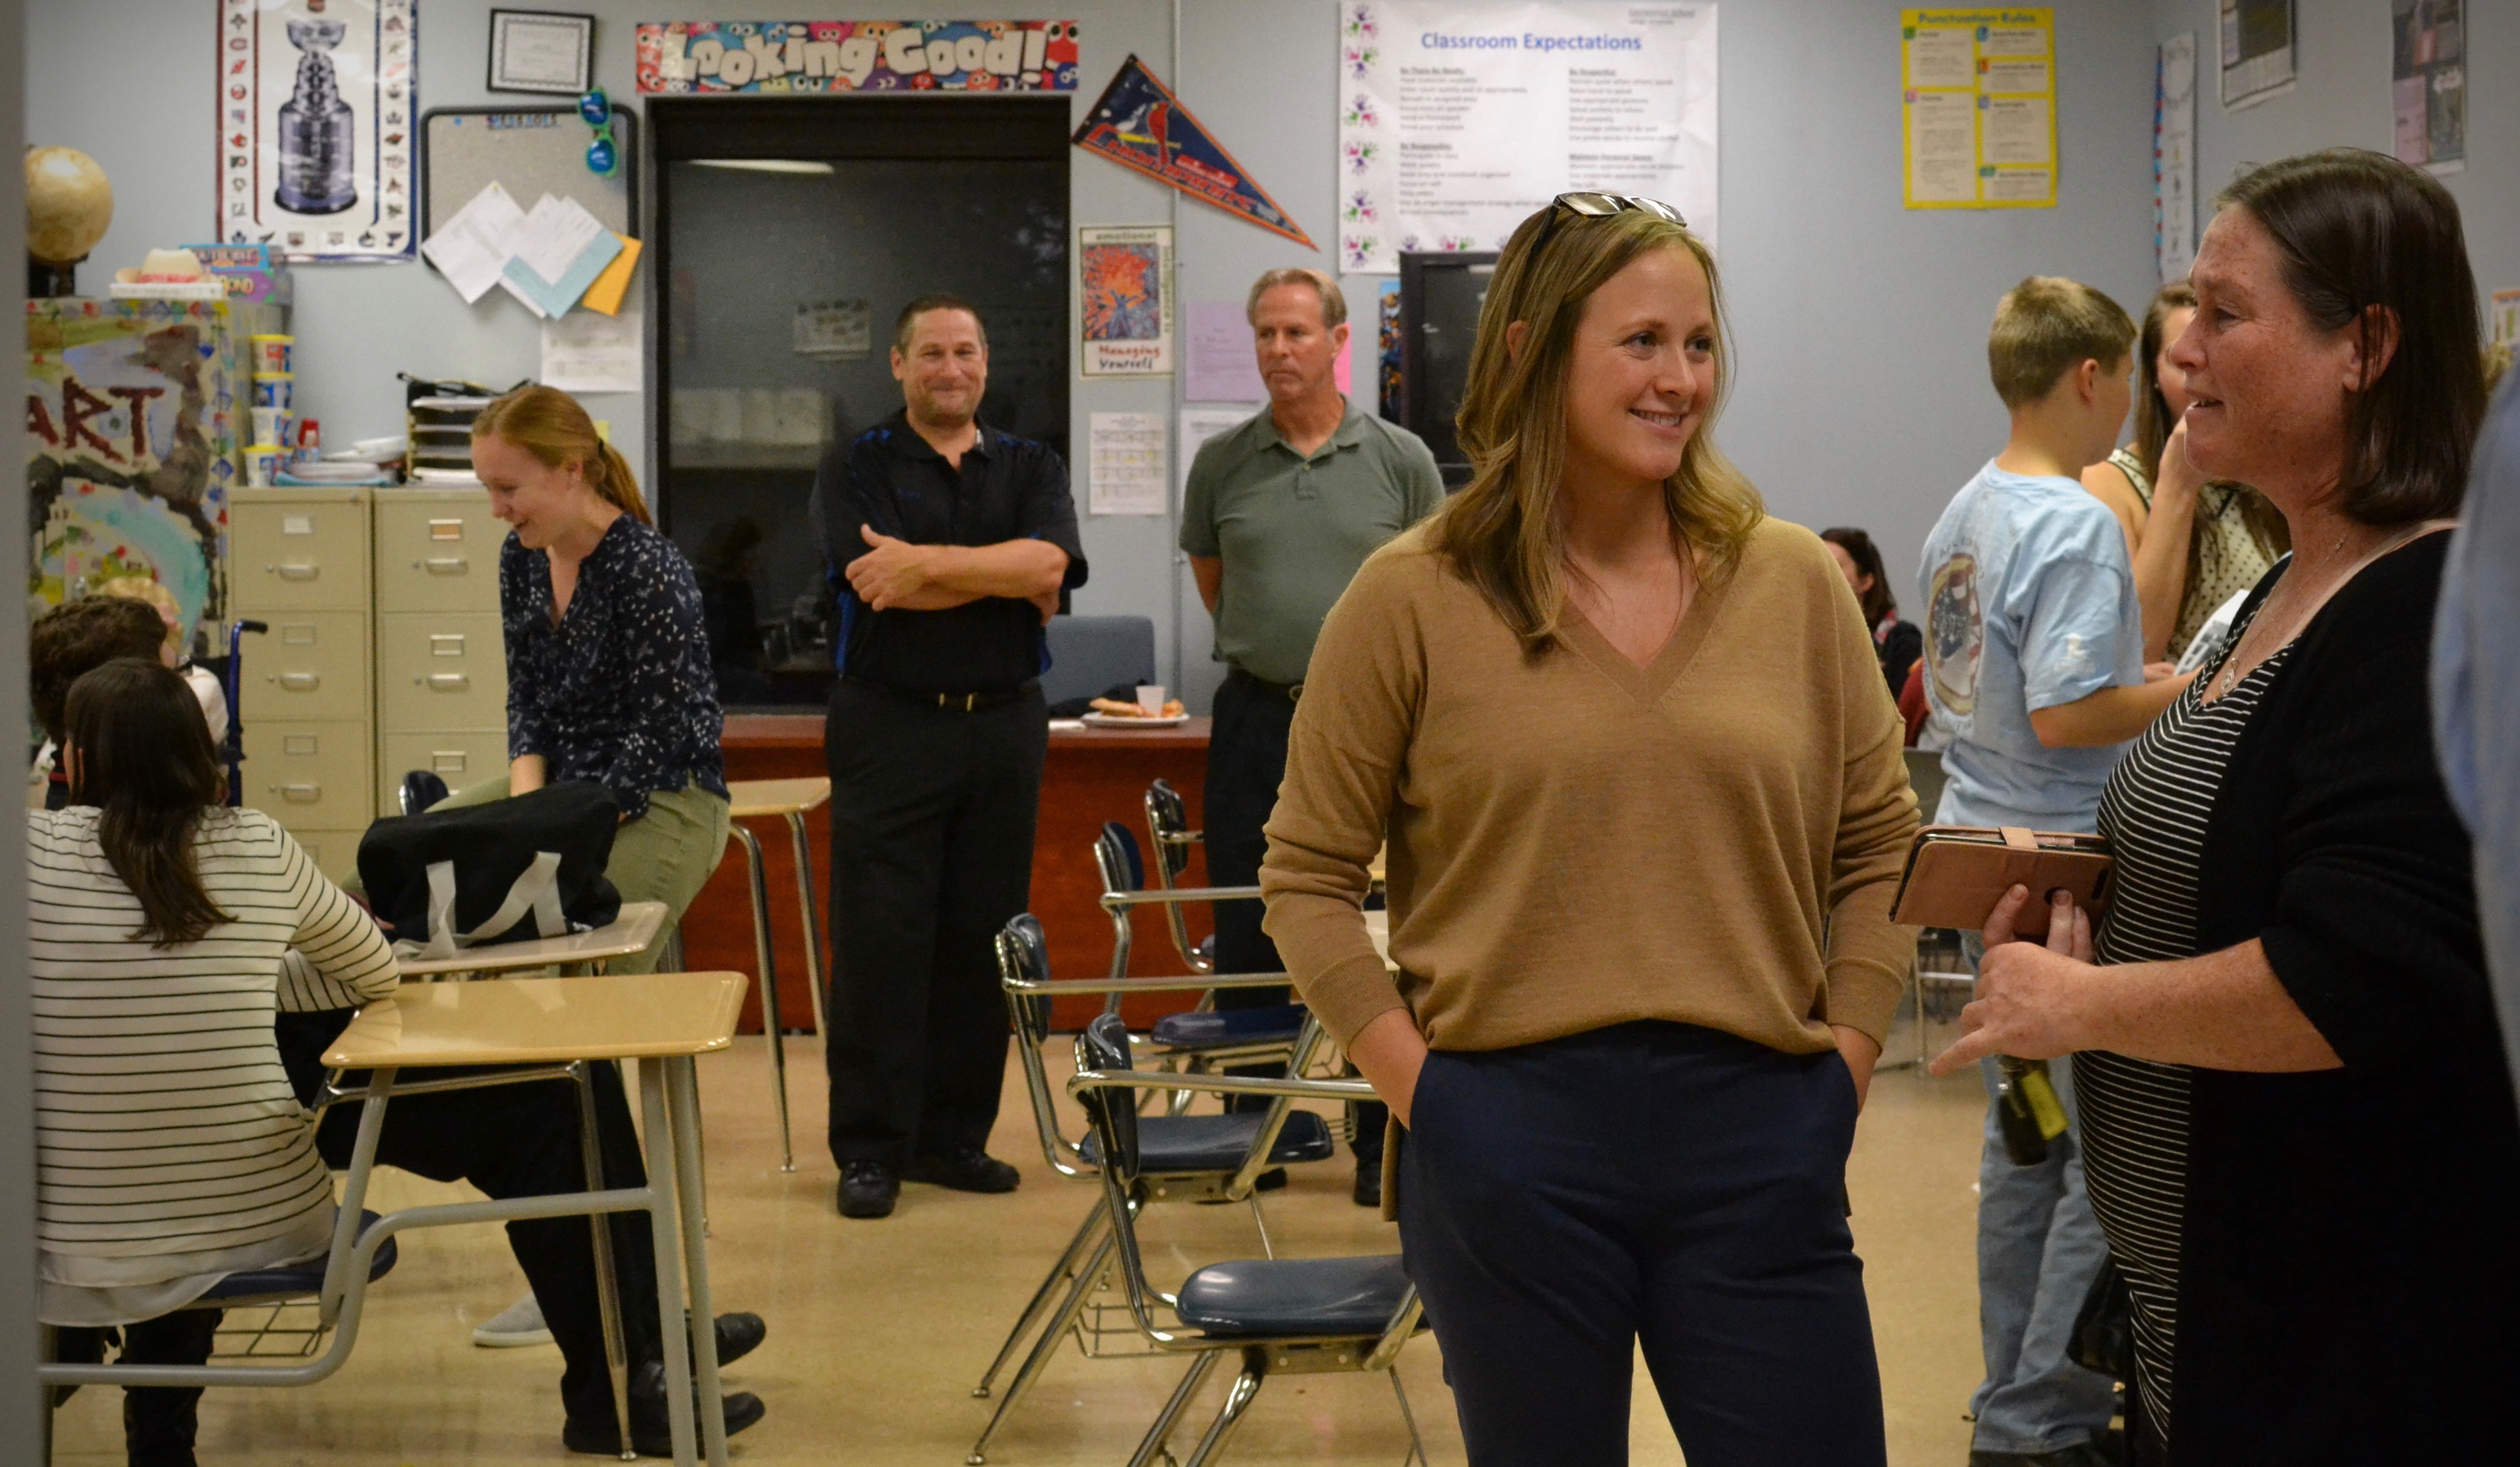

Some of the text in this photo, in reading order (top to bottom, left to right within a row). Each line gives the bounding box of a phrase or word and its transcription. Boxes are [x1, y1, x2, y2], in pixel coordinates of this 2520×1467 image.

[2001, 12, 2037, 23] Rules
[1421, 32, 1642, 53] Classroom Expectations
[660, 26, 1049, 88] Looking Good!
[1097, 231, 1157, 240] emotional
[1099, 345, 1161, 358] Managing
[1099, 357, 1152, 370] Yourself
